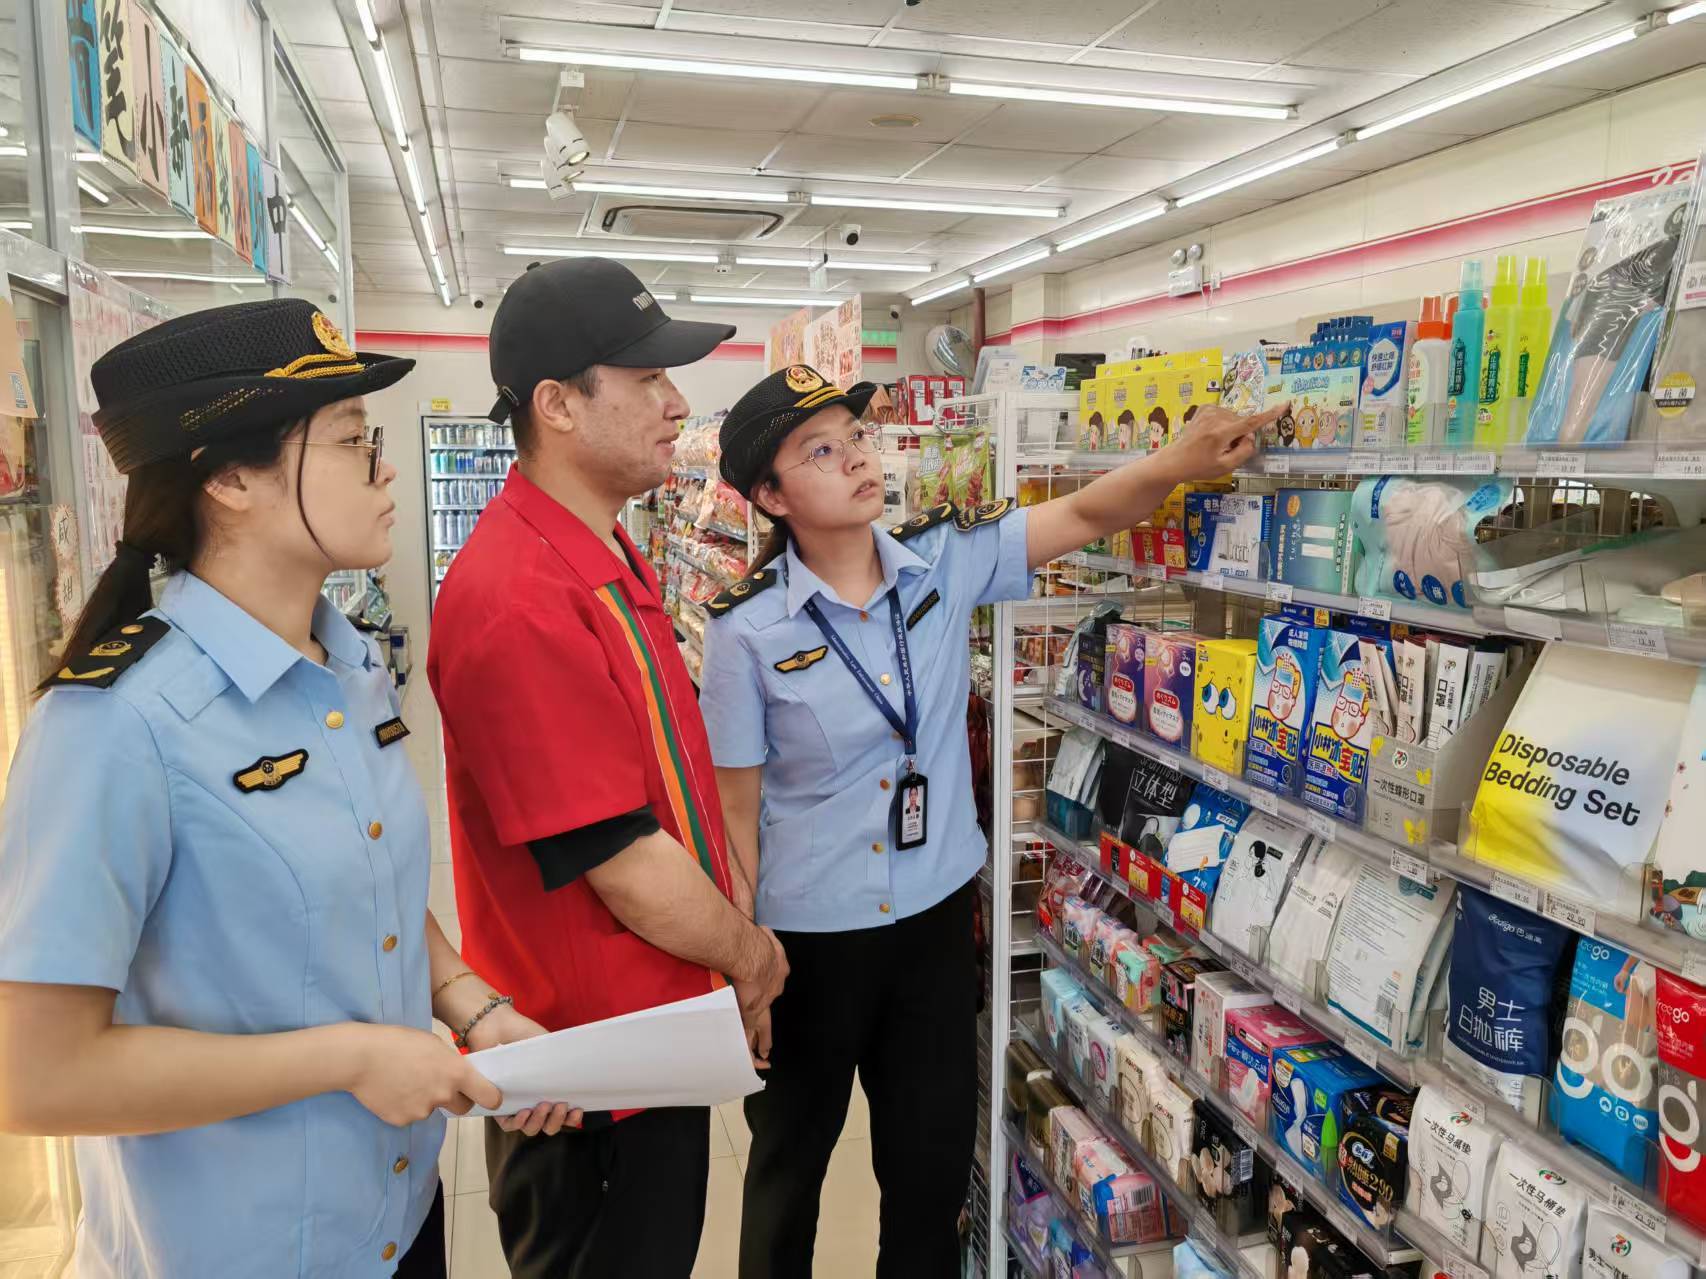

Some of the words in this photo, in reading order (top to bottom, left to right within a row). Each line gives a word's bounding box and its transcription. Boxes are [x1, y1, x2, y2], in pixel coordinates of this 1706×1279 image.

[1254, 714, 1298, 758] 小林冰宝贴
[1314, 732, 1364, 780] 小林冰宝贴
[1498, 733, 1631, 787] Disposable
[1131, 767, 1178, 811] 立体型
[1483, 761, 1578, 811] Bedding
[1583, 789, 1641, 827] Set
[1477, 986, 1526, 1022] 男士
[1458, 1004, 1524, 1052] 日抛裤
[1424, 1116, 1472, 1156] 一次性马桶垫
[1509, 1172, 1568, 1219] 一次性马桶垫
